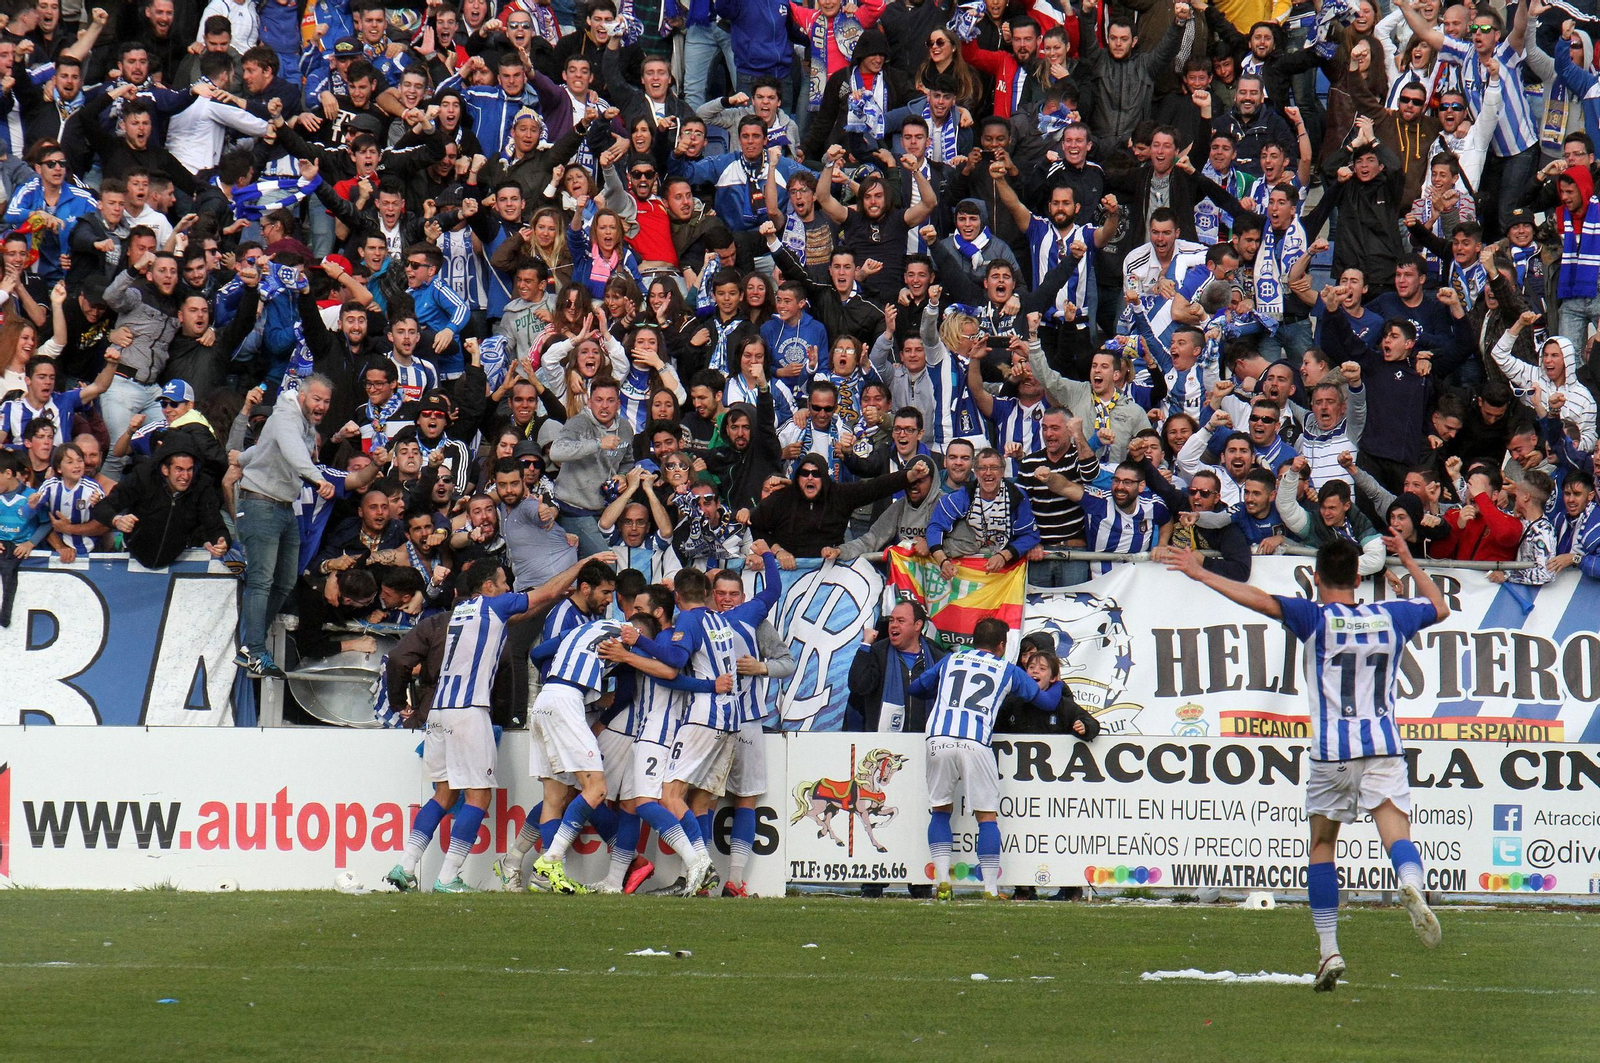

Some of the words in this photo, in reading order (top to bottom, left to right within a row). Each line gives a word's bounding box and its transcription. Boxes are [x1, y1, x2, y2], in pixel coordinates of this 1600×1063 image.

[444, 624, 464, 672] 7
[948, 669, 995, 715] 12
[1331, 652, 1390, 718] 11
[1233, 716, 1308, 738] DECANO
[1456, 719, 1557, 743] ESPAÑOL
[671, 741, 684, 760] 6
[645, 756, 658, 777] 2
[1048, 797, 1133, 819] INFANTIL
[1138, 799, 1165, 820] EN
[1171, 799, 1246, 821] HUELVA
[1533, 809, 1600, 827] Atracci
[1026, 834, 1049, 854] DE
[1054, 832, 1179, 856] CUMPLEAÑOS
[1194, 837, 1262, 858] PRECIO
[1526, 838, 1600, 870] @div
[789, 860, 821, 879] TLF:
[823, 861, 908, 882] 959.22.56.66
